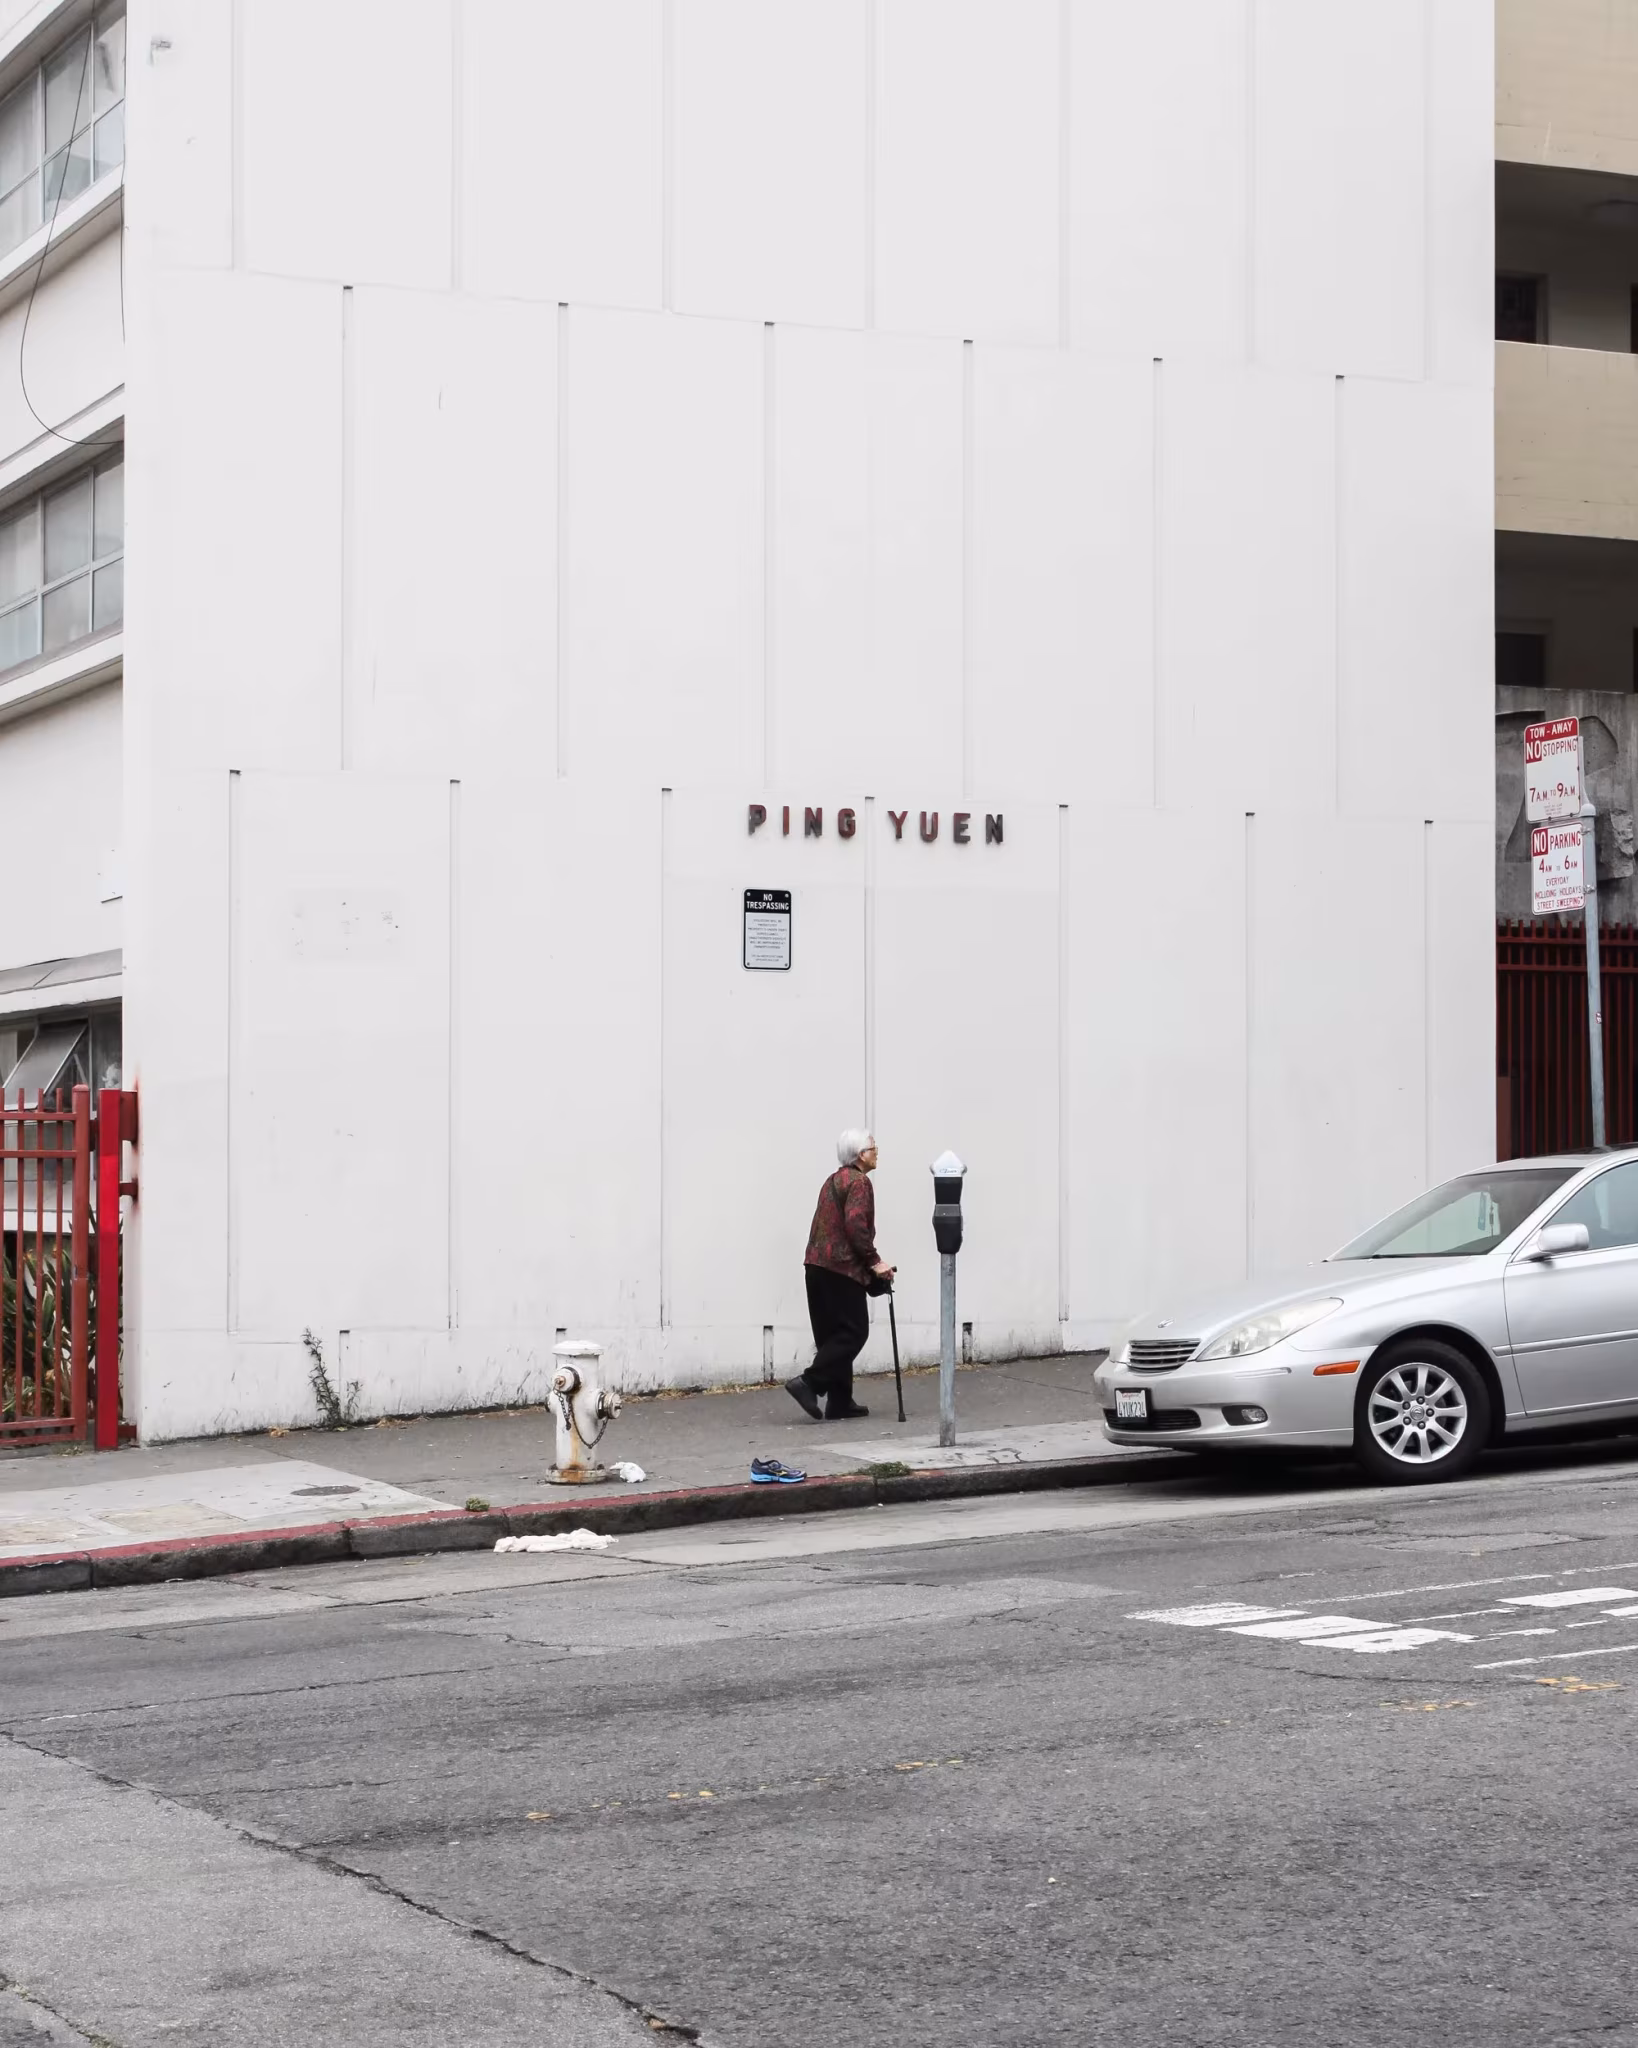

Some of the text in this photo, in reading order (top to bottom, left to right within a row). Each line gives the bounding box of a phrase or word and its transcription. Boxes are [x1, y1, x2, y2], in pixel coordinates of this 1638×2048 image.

[1530, 727, 1545, 739] TOW
[1551, 721, 1573, 735] AWAY
[1526, 737, 1577, 760] NO STOPPING
[1550, 789, 1557, 797] TO
[748, 804, 1004, 843] PING YUEN
[1533, 830, 1581, 854] NO PARKING
[1546, 876, 1569, 887] EVERYDAY
[763, 893, 773, 901] NO
[1535, 885, 1582, 900] INCLUDING HOLIDAYS
[746, 901, 790, 911] TRESPASSING
[1537, 896, 1581, 910] STREET SWEEPING
